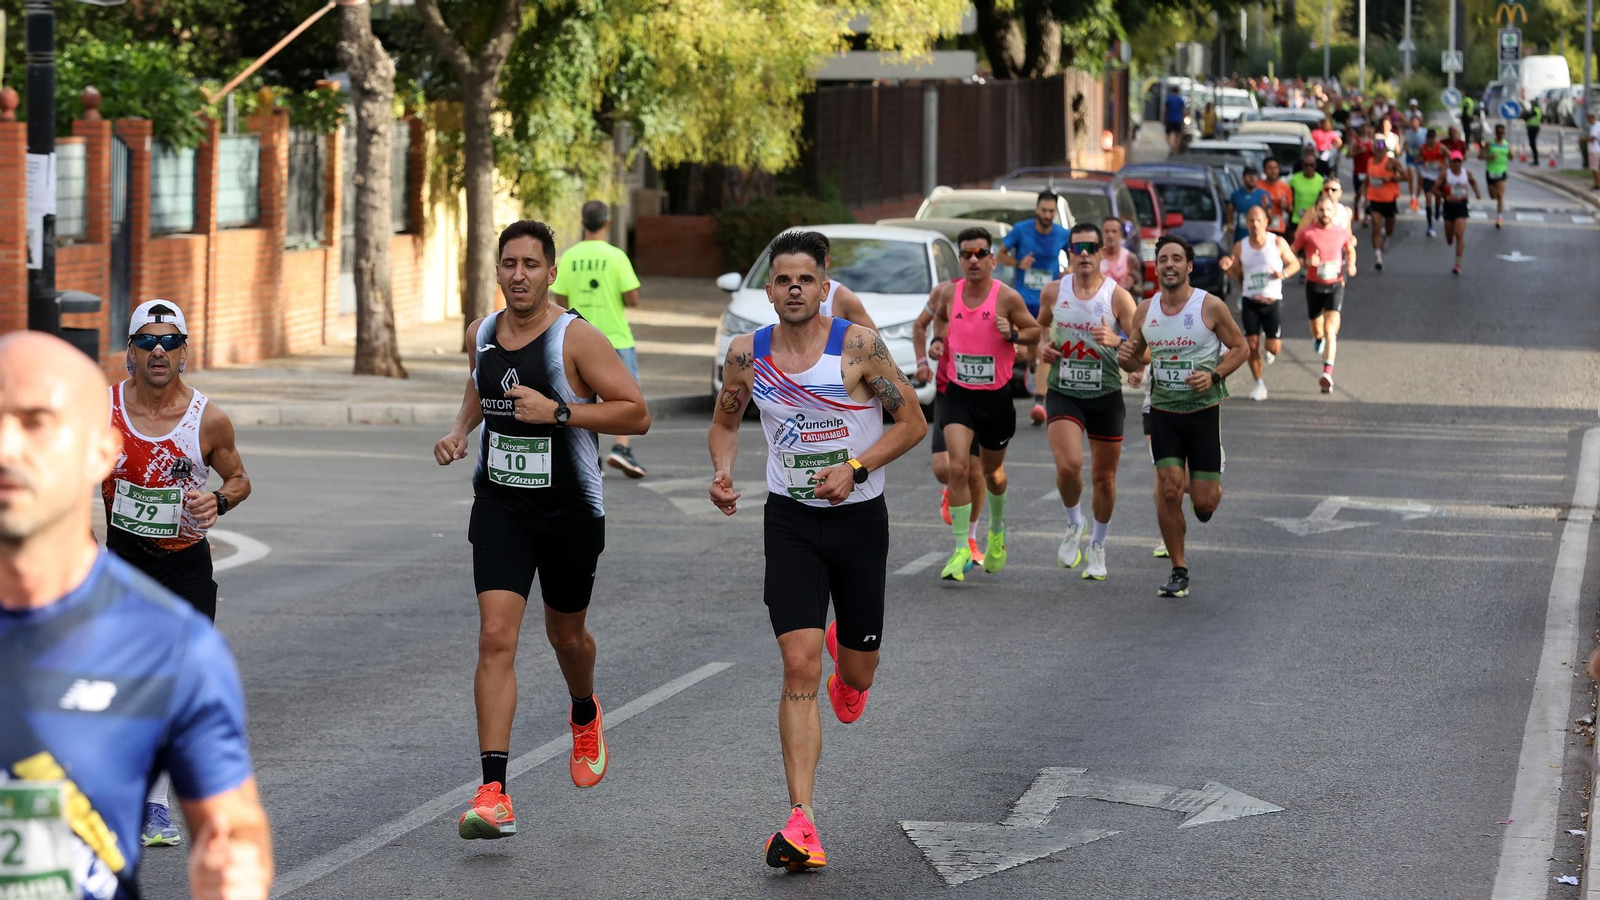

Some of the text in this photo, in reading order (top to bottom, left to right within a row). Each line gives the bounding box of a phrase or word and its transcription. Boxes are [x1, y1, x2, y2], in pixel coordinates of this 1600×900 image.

[572, 260, 607, 272] STAFF
[1057, 322, 1096, 332] marat
[1148, 336, 1197, 347] maratón
[963, 364, 984, 375] 119
[1070, 370, 1091, 380] 105
[1166, 370, 1180, 381] 12
[505, 453, 527, 471] 10
[135, 502, 158, 521] 79
